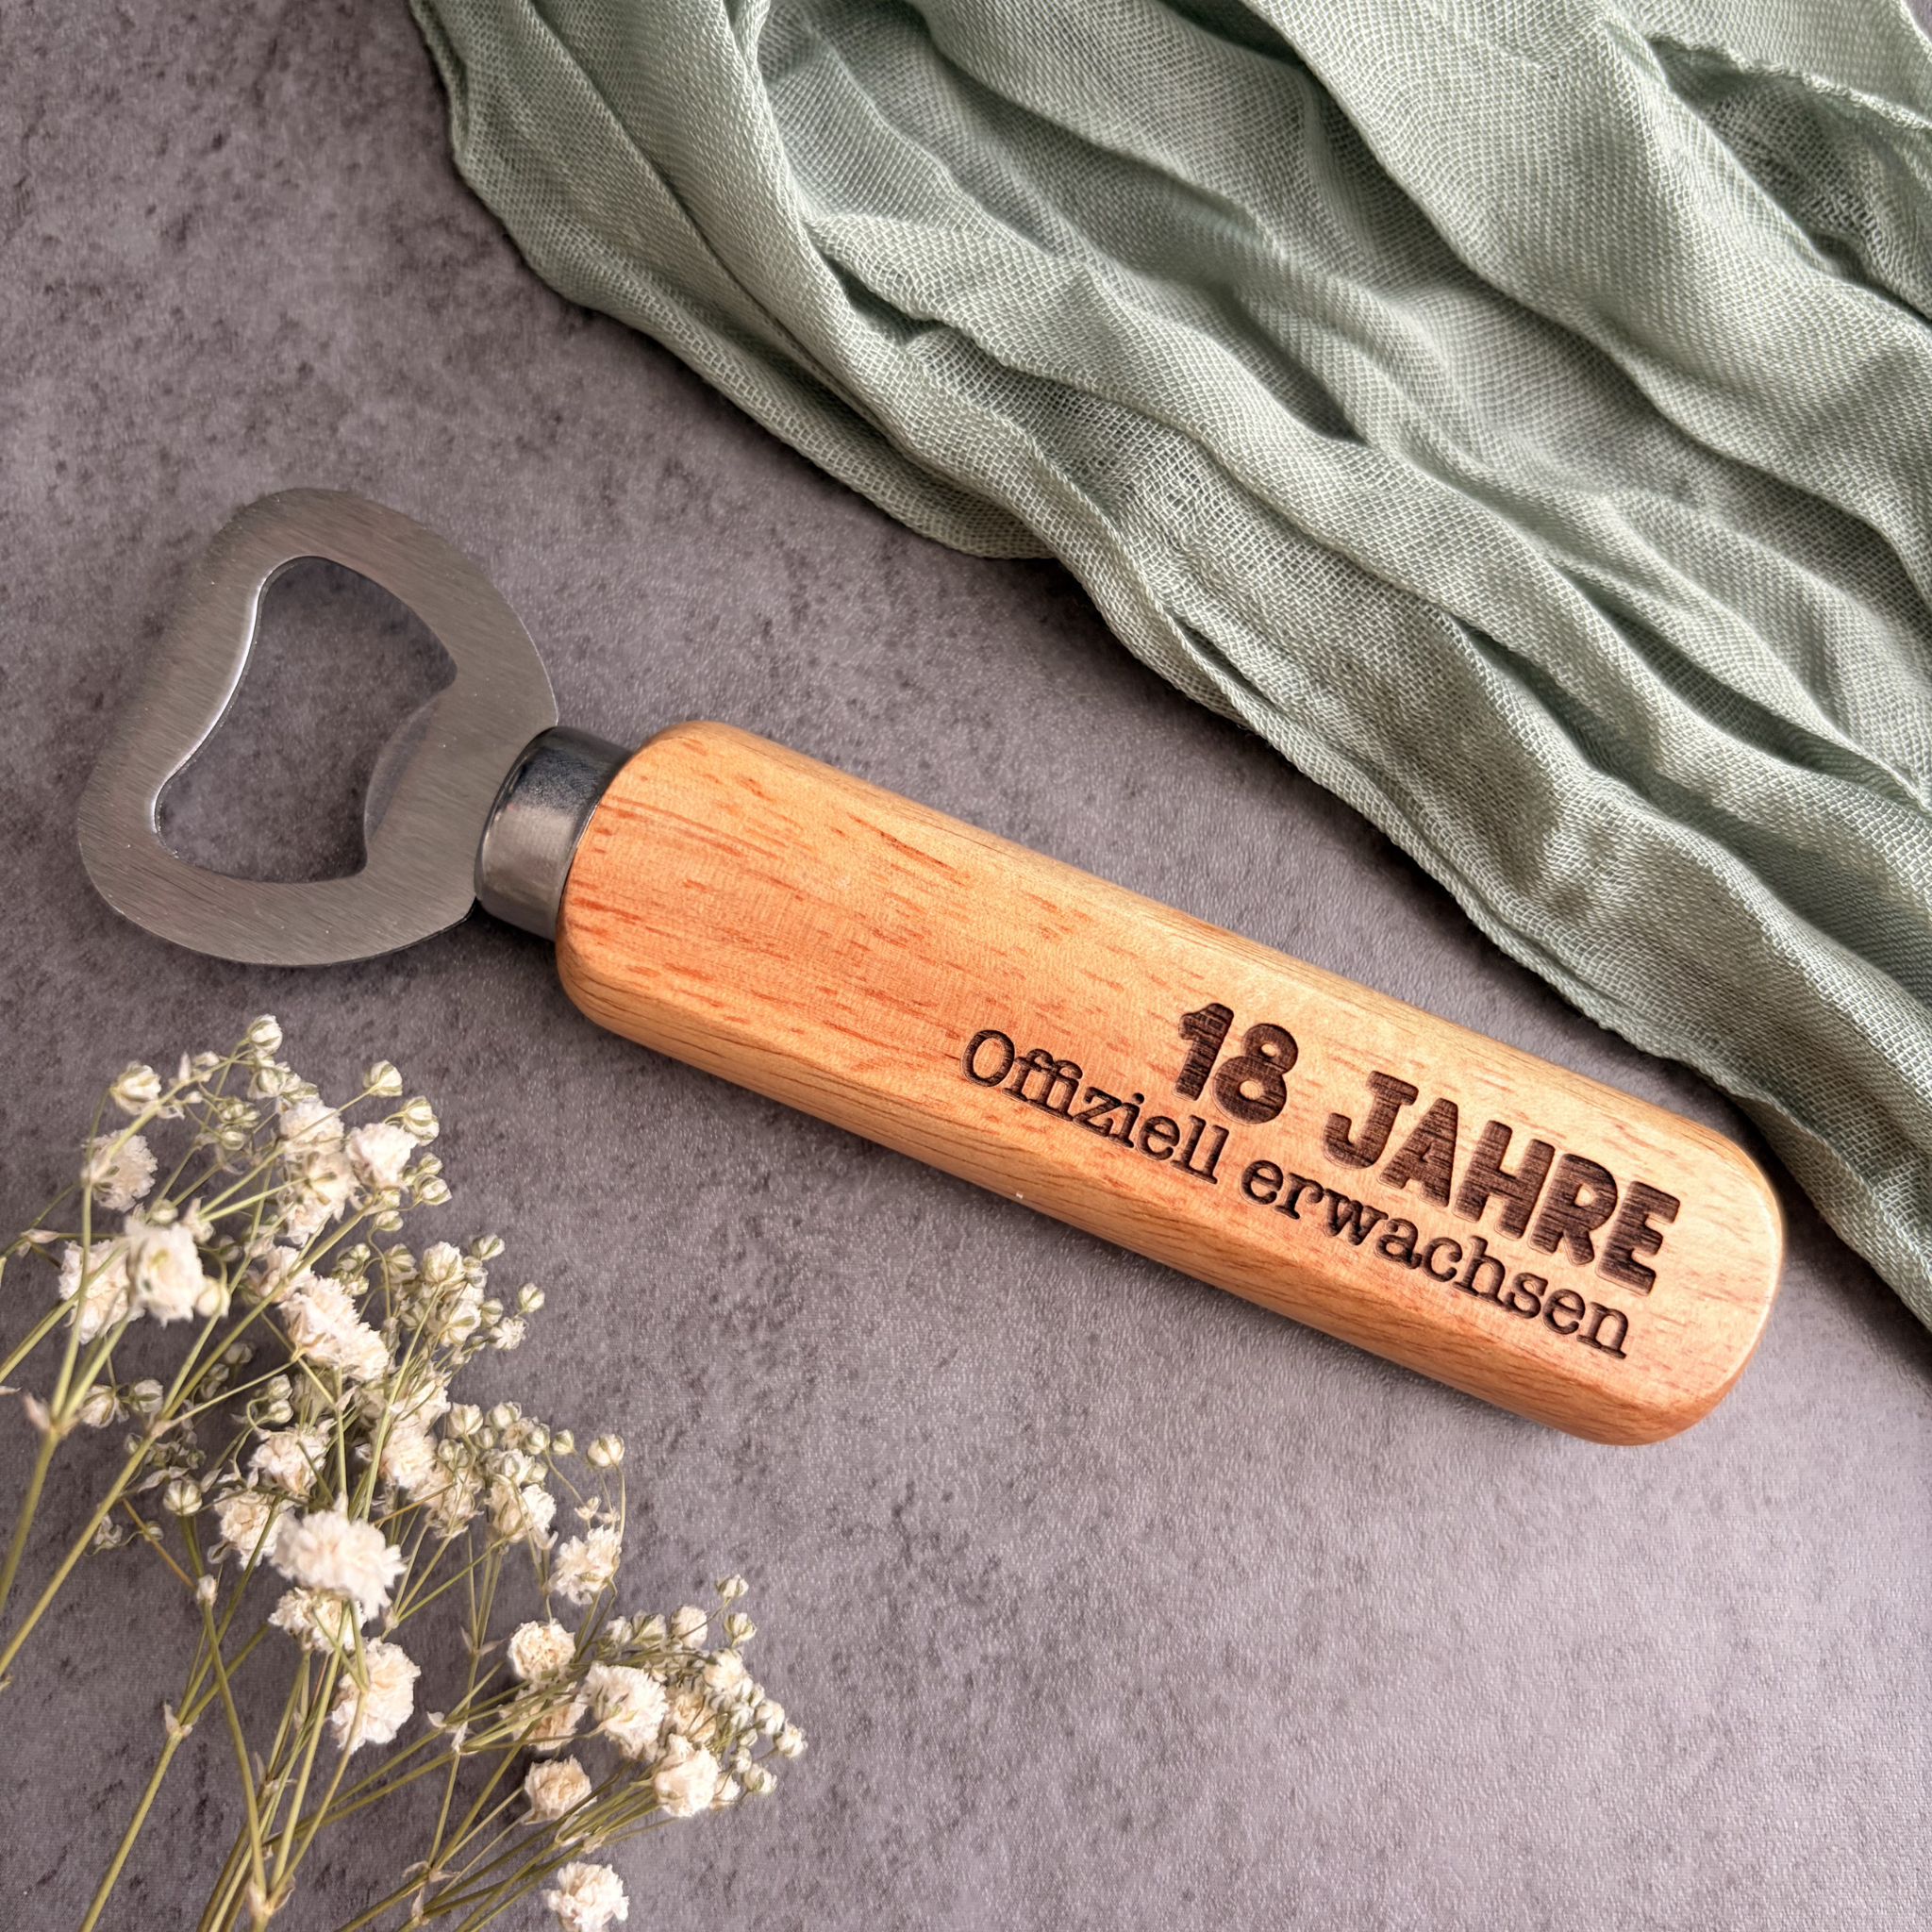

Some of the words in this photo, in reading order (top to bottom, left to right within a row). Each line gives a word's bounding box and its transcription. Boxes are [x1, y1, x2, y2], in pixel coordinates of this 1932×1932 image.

[961, 1028, 1229, 1185] Offiziell
[1240, 1159, 1629, 1360] erwachsen
[1175, 1002, 1299, 1124] 18
[1323, 1070, 1681, 1295] JAHRE
